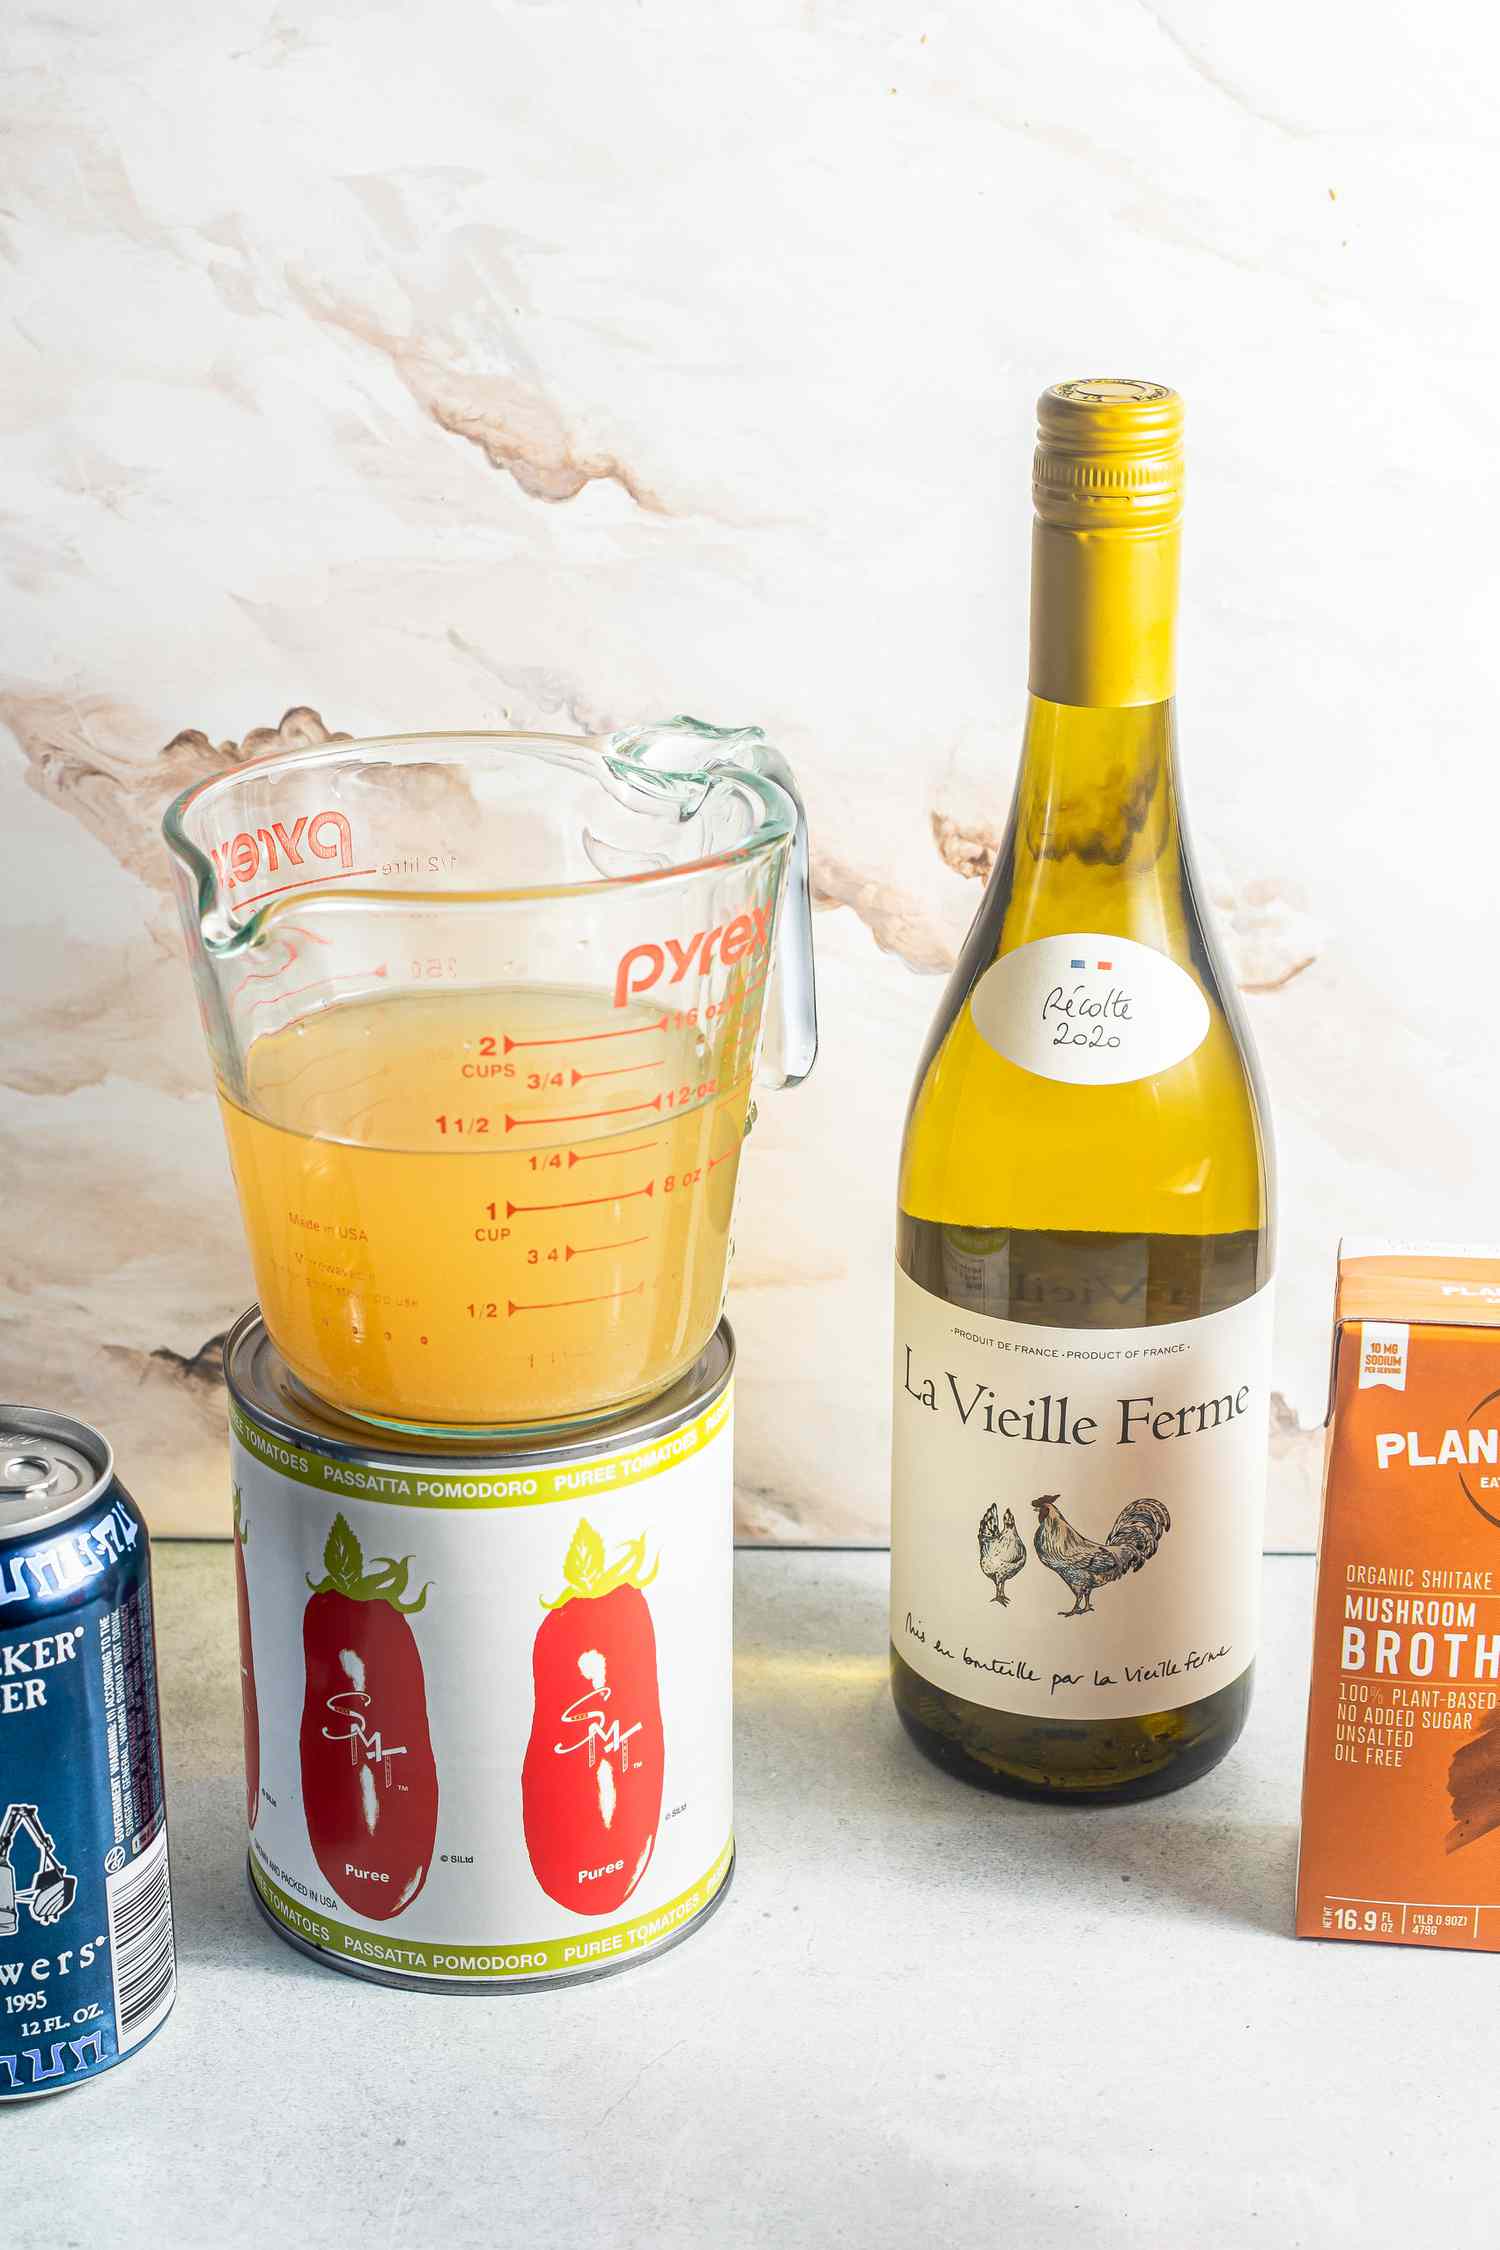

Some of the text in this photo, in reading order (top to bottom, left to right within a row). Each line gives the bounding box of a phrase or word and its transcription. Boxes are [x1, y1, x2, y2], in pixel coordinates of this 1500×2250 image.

[613, 896, 772, 1008] pyrex
[1042, 985, 1133, 1020] Récolte
[479, 1036, 497, 1056] 2
[1053, 1022, 1121, 1048] 2020
[461, 1063, 516, 1079] CUPS
[527, 1072, 564, 1092] 3/4
[667, 1086, 691, 1108] 12
[528, 1152, 562, 1172] 1/4
[664, 1168, 702, 1192] 8 oz
[486, 1202, 496, 1221] 1
[339, 1226, 369, 1243] USA
[475, 1228, 511, 1242] CUP
[466, 1303, 498, 1320] 1/2
[953, 1327, 1186, 1360] PRODUIT DE FRANCE PRODUCT OF FRANCE
[1371, 1342, 1398, 1354] 10 MG
[1365, 1354, 1402, 1366] SODIUM
[905, 1343, 1249, 1445] La Vieille Ferme
[245, 1425, 309, 1473] TOMATOES
[323, 1465, 411, 1496] PASSATTA
[416, 1478, 538, 1498] POMODORO
[554, 1463, 617, 1492] PUREE
[621, 1428, 698, 1477] TOMATOES
[1376, 1429, 1498, 1470] PLAN
[1346, 1564, 1493, 1590] ORGANIC SHIITAKE
[1344, 1594, 1477, 1628] MUSHROOM
[99, 1615, 111, 1637] THE
[110, 1608, 122, 1641] DRINK
[0, 1631, 77, 1677] KER
[100, 1637, 113, 1652] TO
[112, 1641, 124, 1662] NOT
[1341, 1626, 1500, 1680] BROTH
[101, 1651, 116, 1709] ACCORDING
[114, 1664, 126, 1702] SHOULD
[1050, 1673, 1085, 1695] par
[1094, 1670, 1118, 1686] la
[1125, 1661, 1181, 1683] Vieille
[1338, 1682, 1497, 1710] 100% PLANT-BASED
[116, 1703, 128, 1744] WOMEN
[1337, 1703, 1473, 1730] NO ADDED SUGAR
[107, 1721, 120, 1775] WARNING:
[1335, 1724, 1414, 1748] UNSALTED
[1335, 1743, 1403, 1768] OIL FREE
[111, 1775, 125, 1844] GOVERNMENT
[122, 1791, 134, 1837] SURGEON
[345, 1863, 391, 1883] Puree
[578, 1859, 624, 1884] Puree
[280, 1870, 308, 1896] PACKED
[309, 1890, 318, 1902] IN
[320, 1894, 338, 1911] USA
[268, 1888, 331, 1942] TOMATOES
[344, 1935, 428, 1968] PASSATTA
[432, 1952, 548, 1971] POMODORO
[563, 1934, 624, 1962] PUREE
[626, 1893, 700, 1945] TOMATOES
[1334, 1908, 1377, 1931] 16.9
[1381, 1922, 1393, 1933] OZ
[1382, 1911, 1392, 1923] FL
[5, 1990, 48, 2014] 1995
[21, 2002, 104, 2037] 12 FL. OZ.
